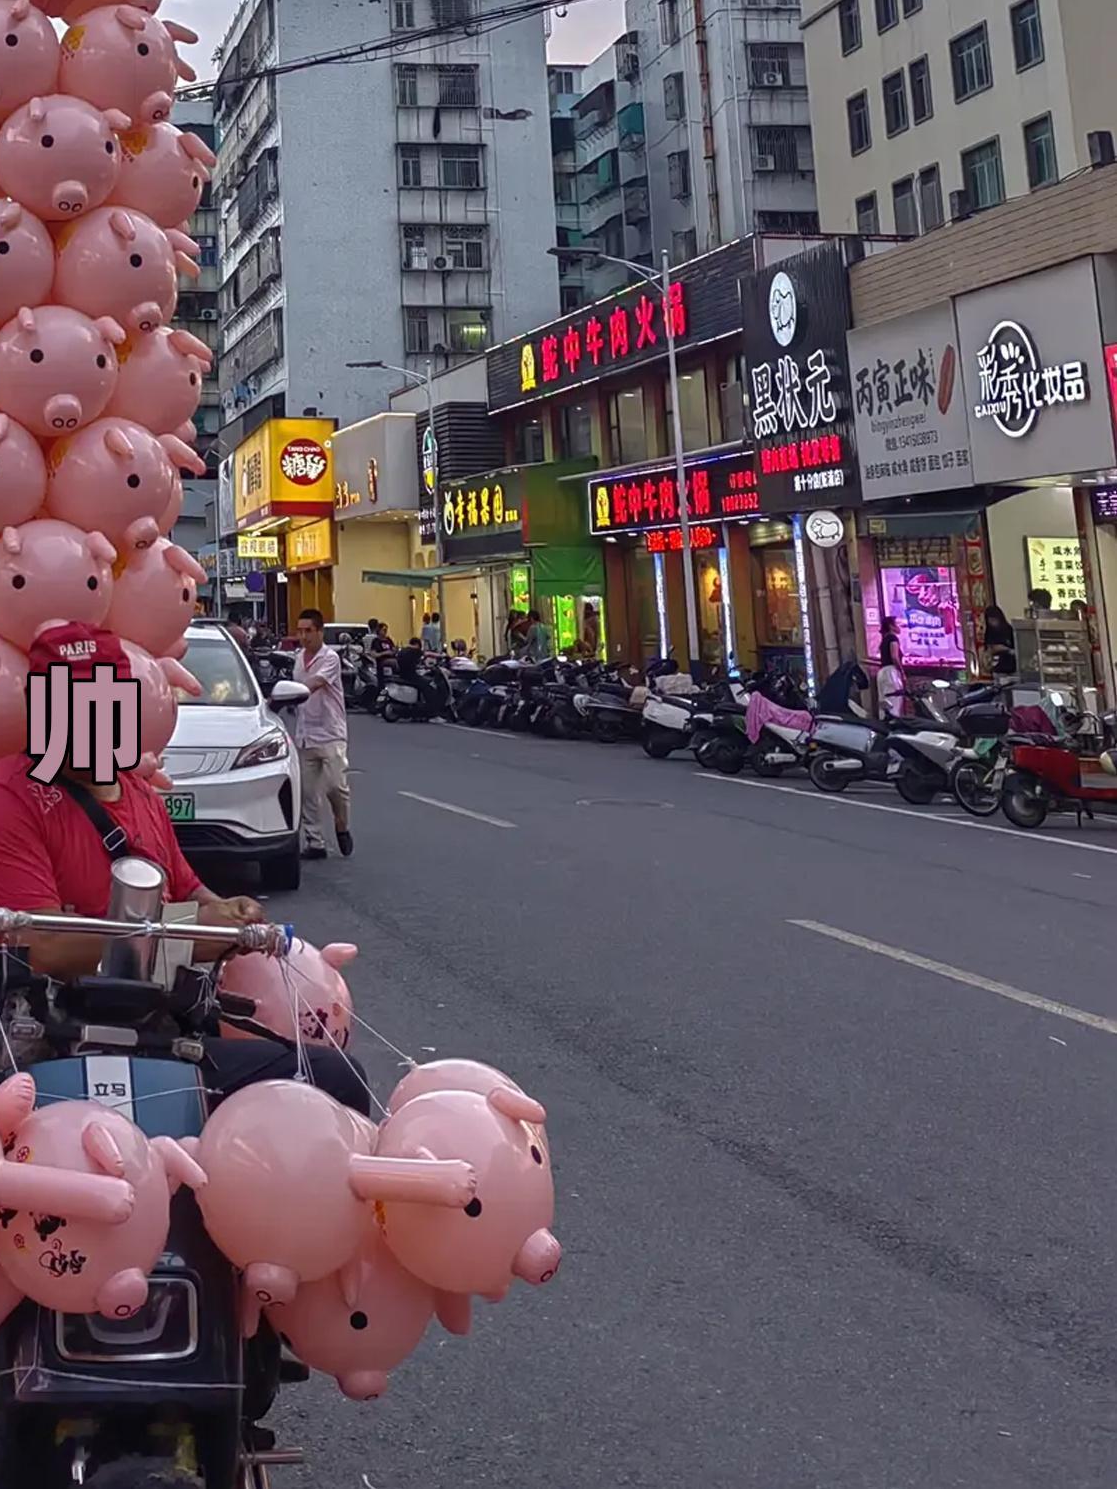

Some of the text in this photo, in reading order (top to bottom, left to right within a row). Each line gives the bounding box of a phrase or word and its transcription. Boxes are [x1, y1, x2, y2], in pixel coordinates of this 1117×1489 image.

[751, 349, 836, 439] 黑状元
[59, 639, 97, 657] PARIS
